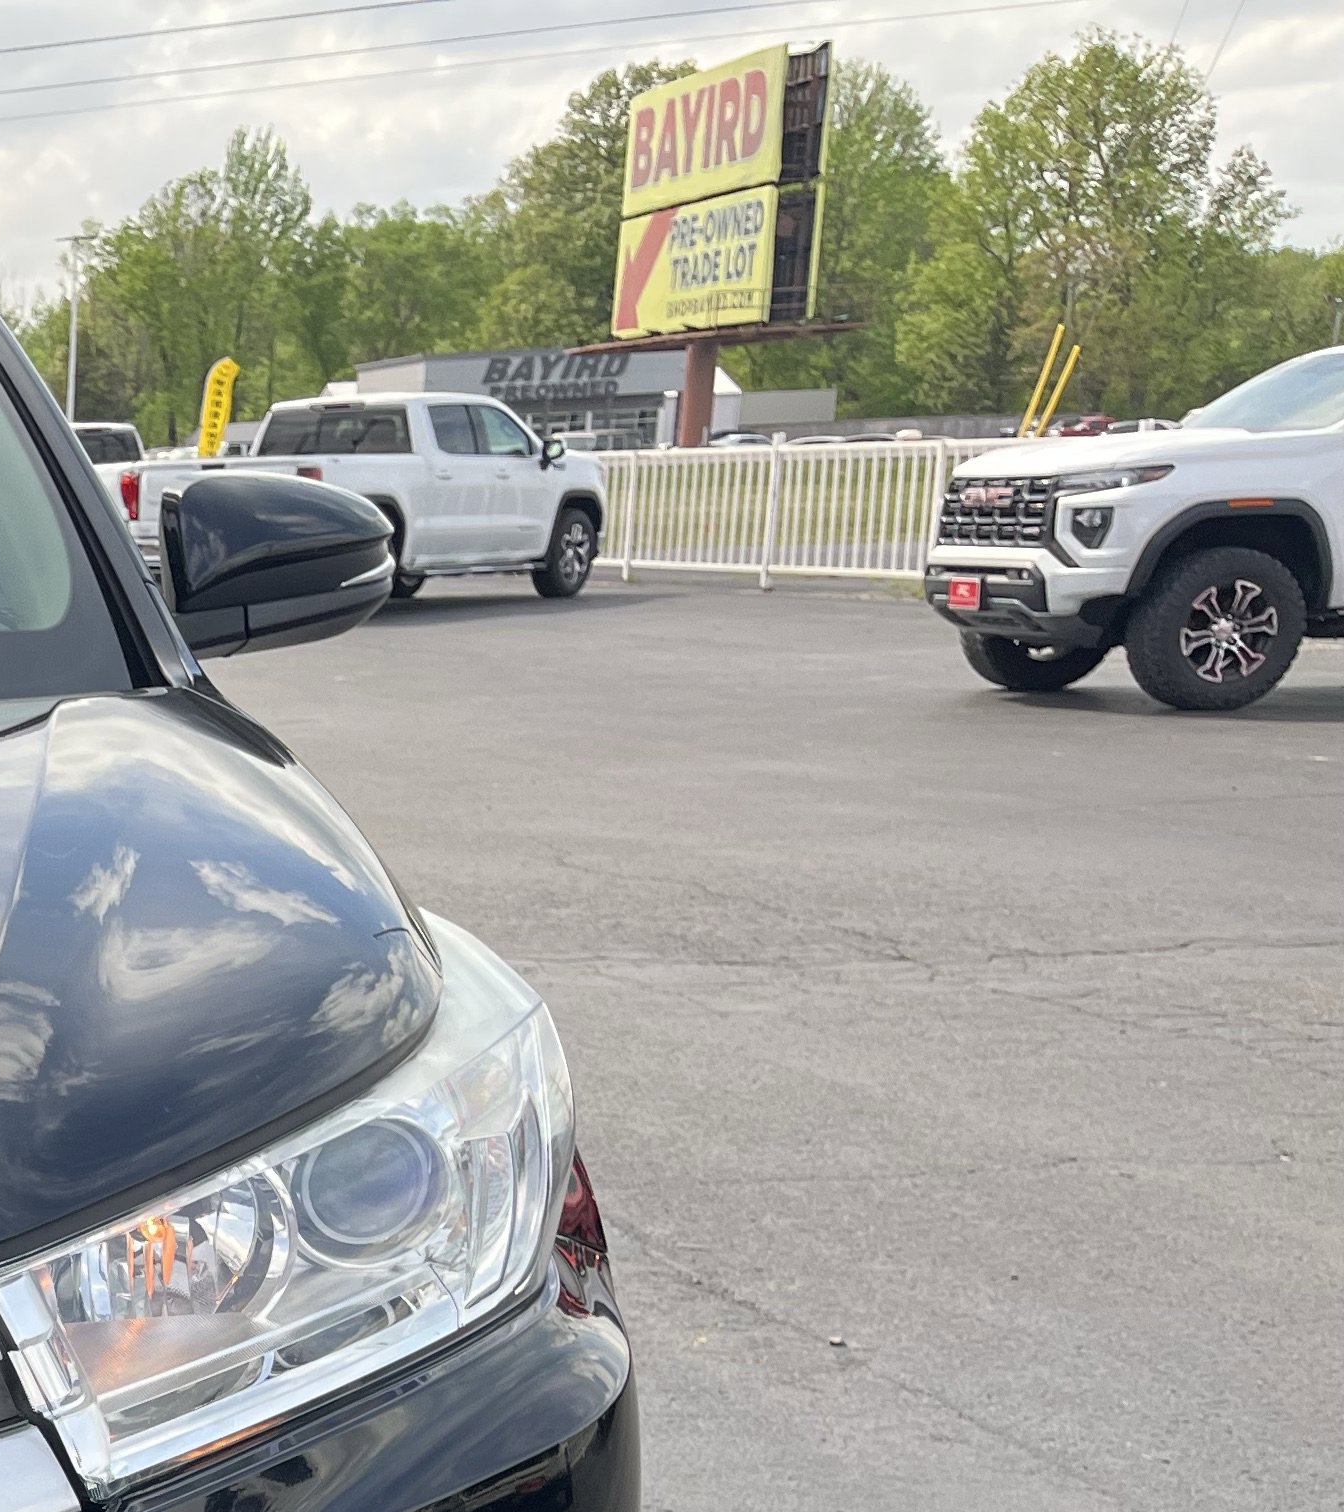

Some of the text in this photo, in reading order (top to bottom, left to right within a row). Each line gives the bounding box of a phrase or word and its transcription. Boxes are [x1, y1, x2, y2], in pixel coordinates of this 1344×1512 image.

[631, 69, 767, 189] BAYIRD
[670, 199, 764, 249] PRE-OWNED
[671, 240, 757, 290] TRADE LOT
[483, 351, 631, 384] BAYIRD
